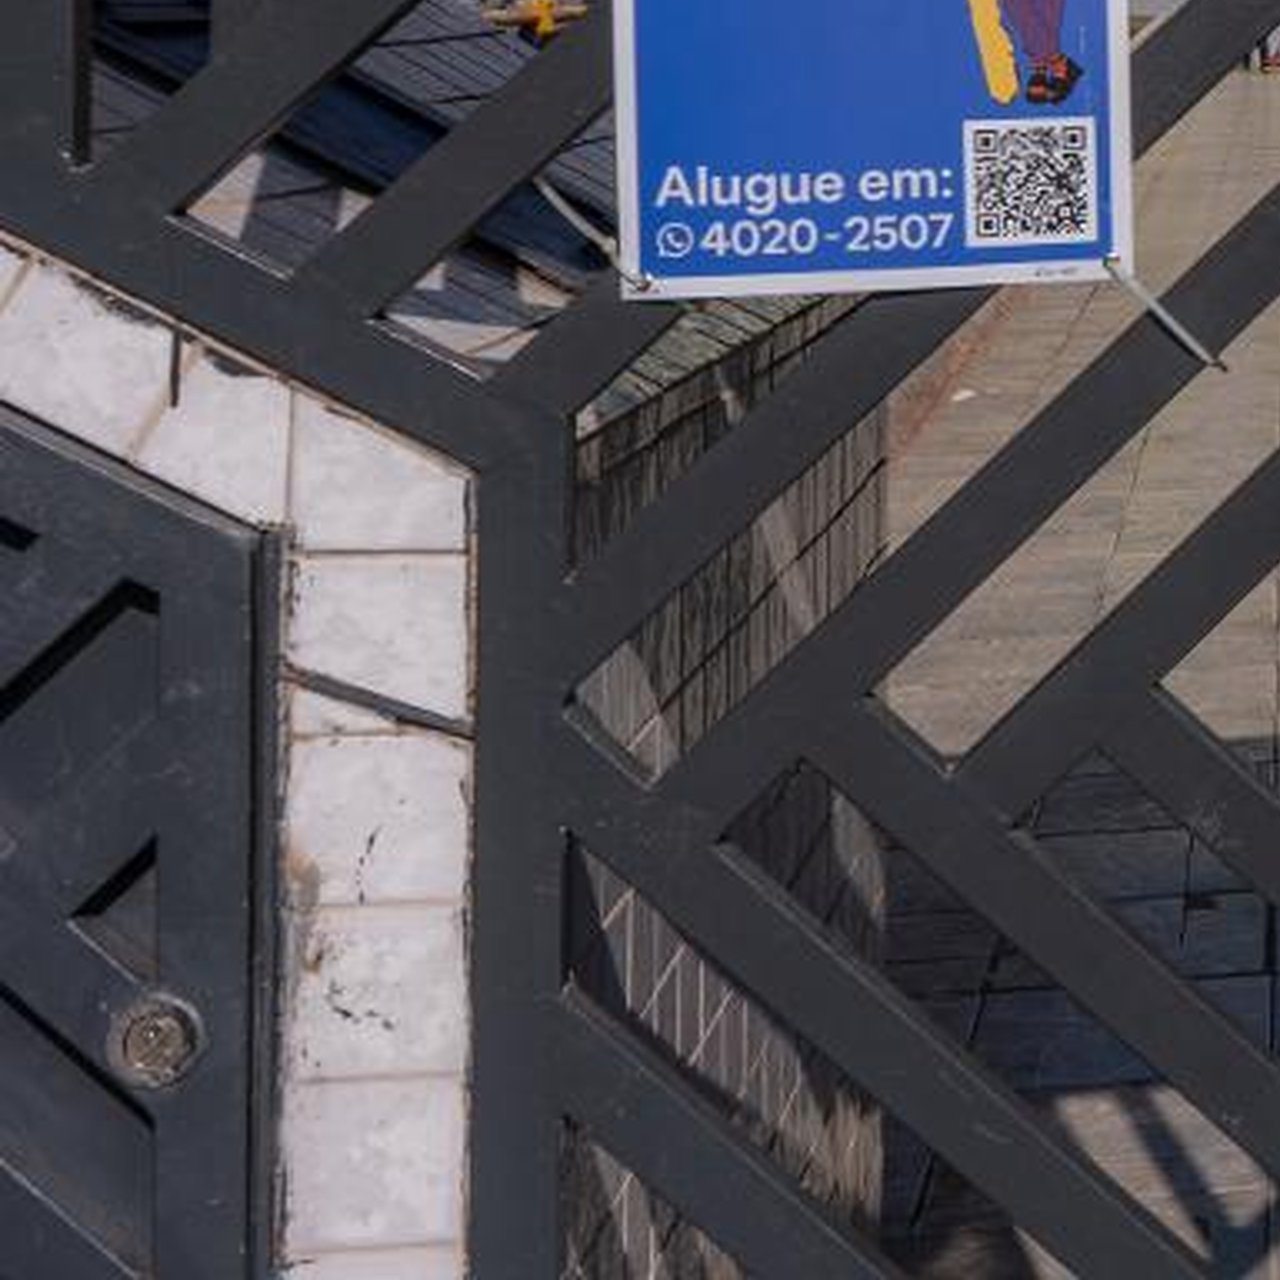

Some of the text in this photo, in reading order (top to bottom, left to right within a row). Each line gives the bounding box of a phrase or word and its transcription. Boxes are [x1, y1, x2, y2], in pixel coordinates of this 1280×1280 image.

[656, 166, 954, 213] Alugue em:
[700, 213, 954, 256] 4020-2507
